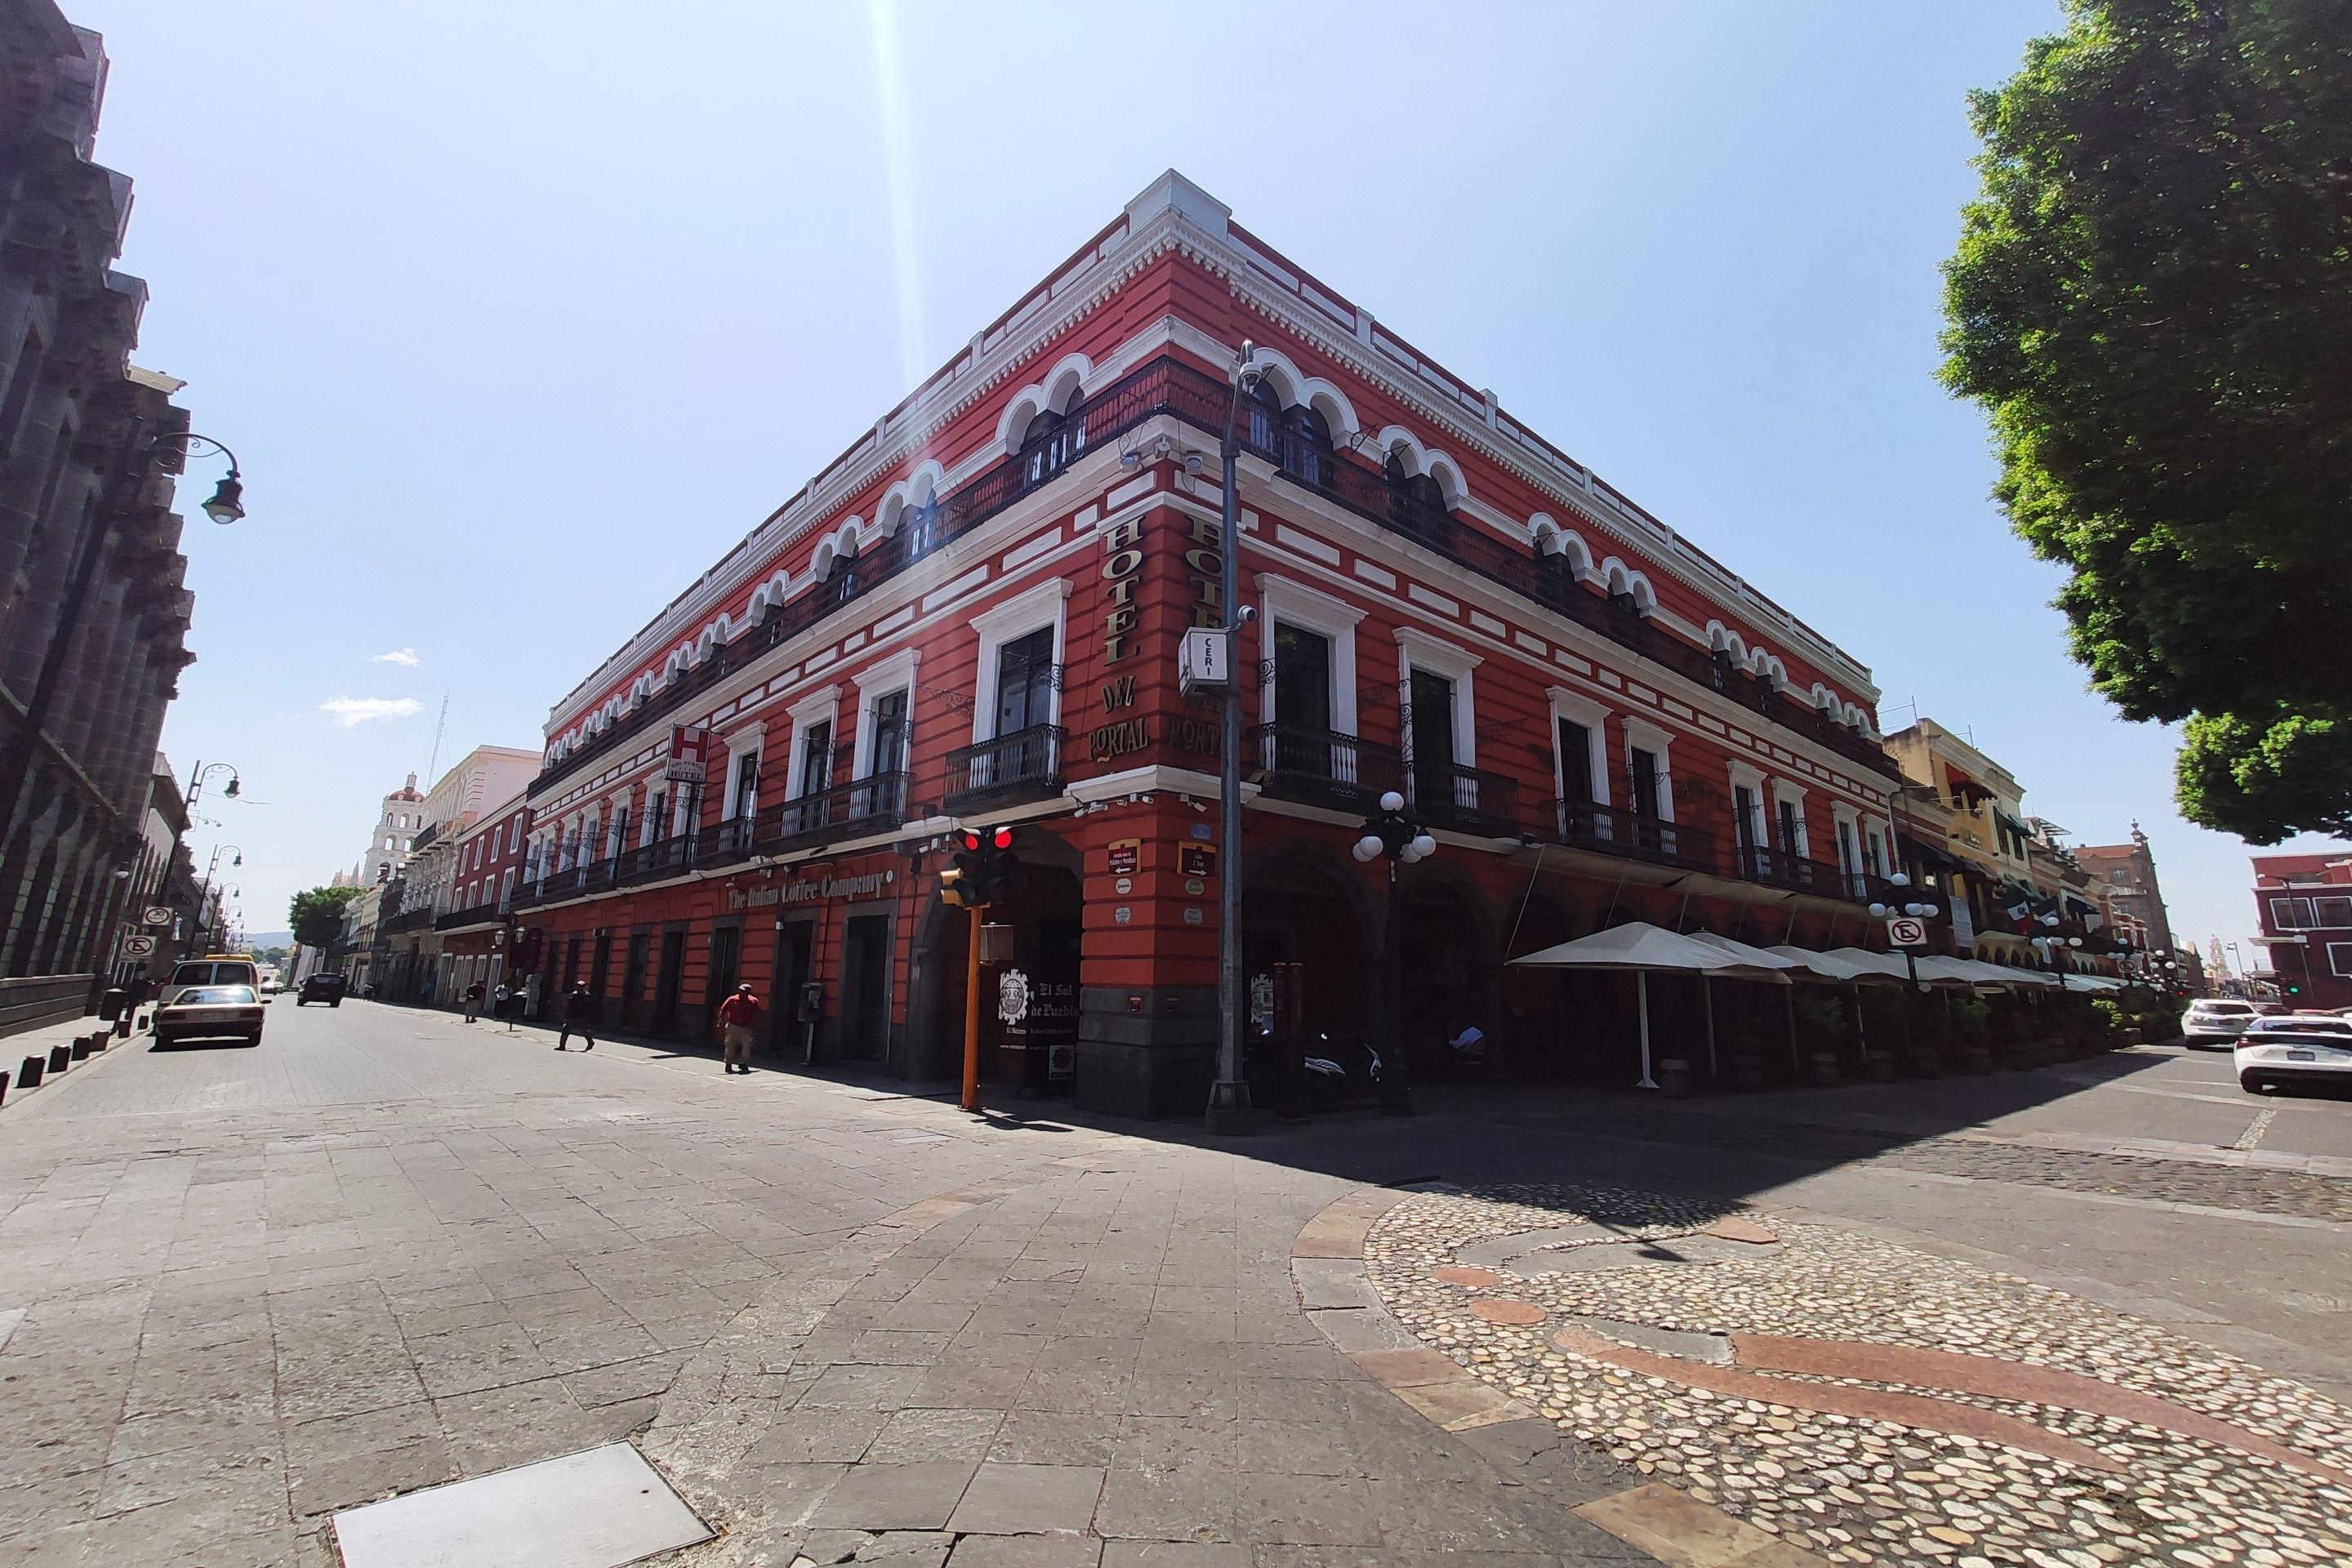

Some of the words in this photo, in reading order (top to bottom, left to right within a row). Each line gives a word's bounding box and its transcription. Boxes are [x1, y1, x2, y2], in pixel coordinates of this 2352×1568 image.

[1102, 514, 1145, 667] HOTEL
[1185, 514, 1223, 629] HOTE
[1205, 637, 1213, 676] CERI
[1102, 675, 1136, 714] DEL
[672, 727, 709, 763] H
[1087, 717, 1149, 761] PORTAL
[1168, 715, 1222, 757] PORT
[670, 769, 703, 780] HOTEL
[728, 889, 746, 909] The
[747, 884, 778, 907] Italian
[782, 879, 817, 903] Coffee
[821, 873, 884, 901] Company
[1039, 982, 1052, 996] El
[1054, 984, 1072, 996] Sol
[1031, 1004, 1042, 1017] de
